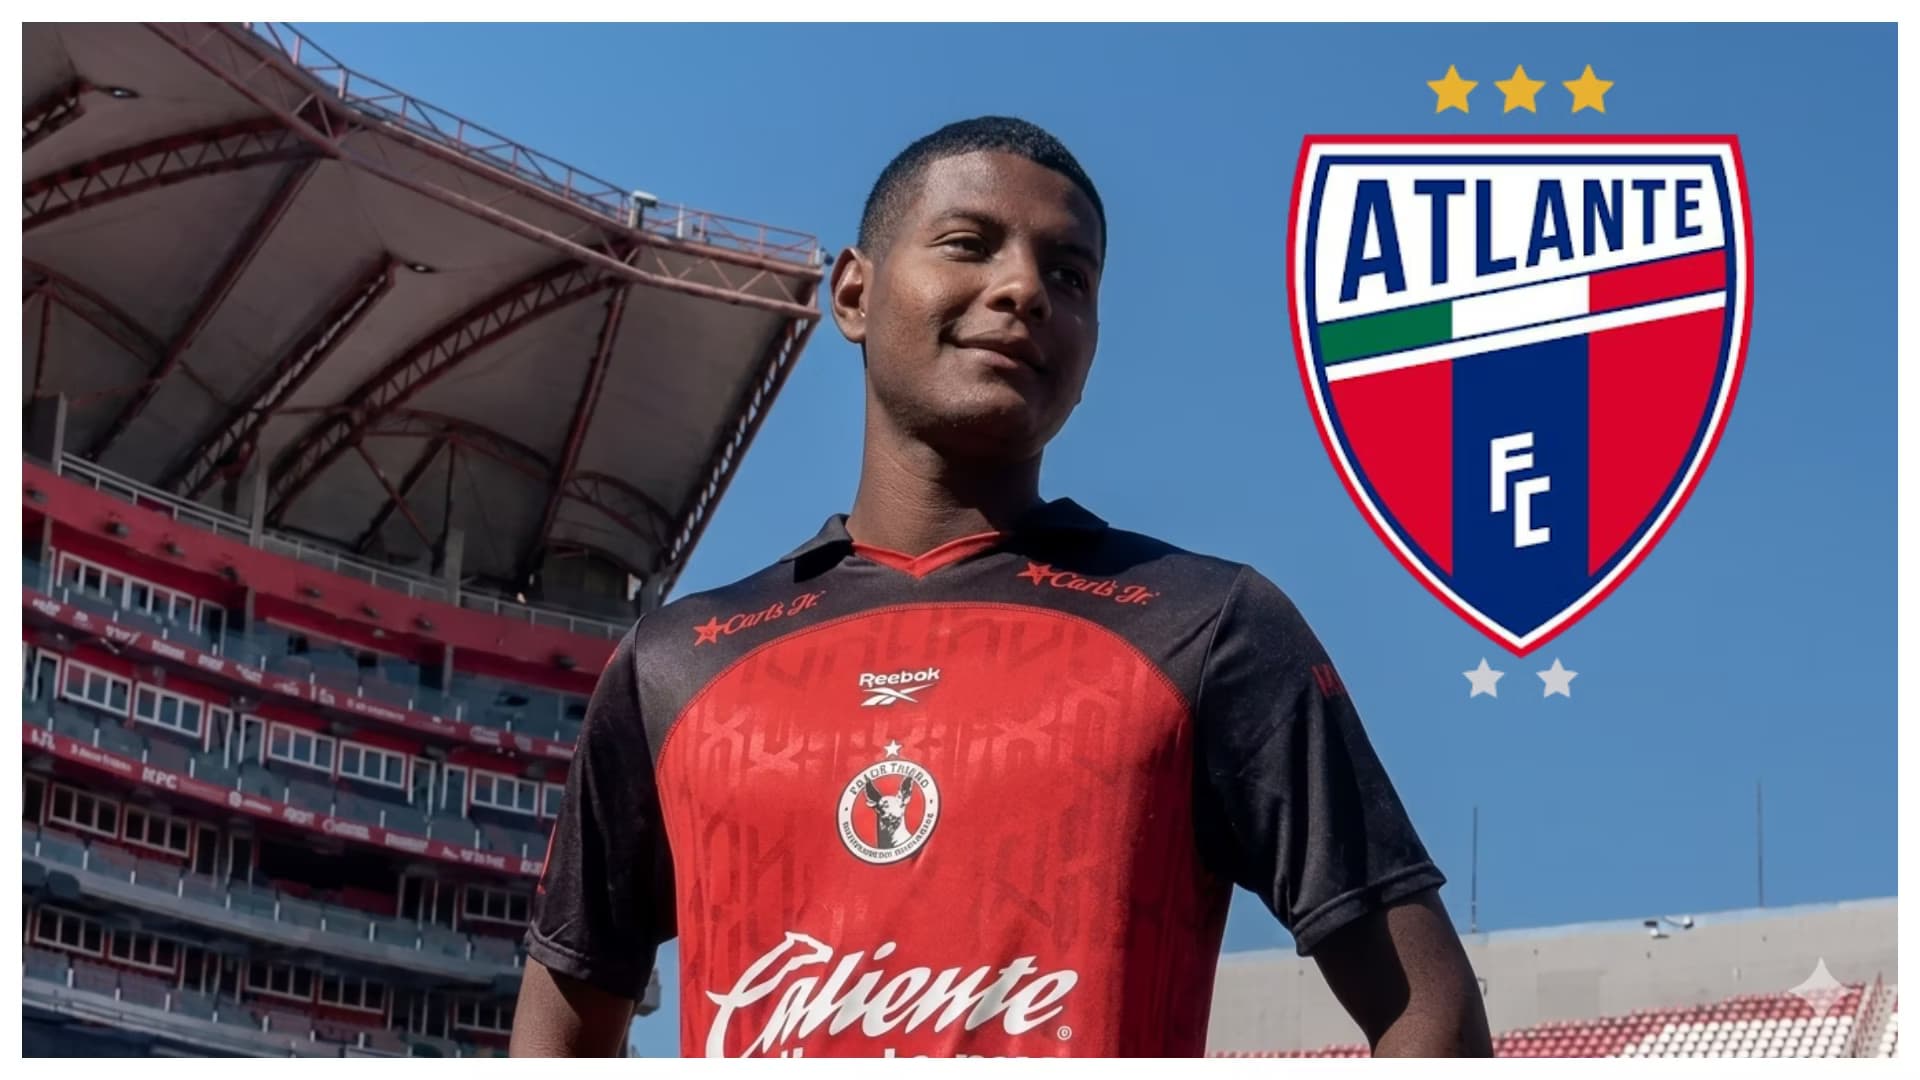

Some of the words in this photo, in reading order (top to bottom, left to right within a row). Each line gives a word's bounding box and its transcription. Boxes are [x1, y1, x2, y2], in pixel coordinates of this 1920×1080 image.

[1050, 571, 1119, 597] Carl's
[1115, 585, 1154, 606] Jr.
[859, 667, 941, 688] Reebok
[705, 930, 1079, 1058] Caliente
